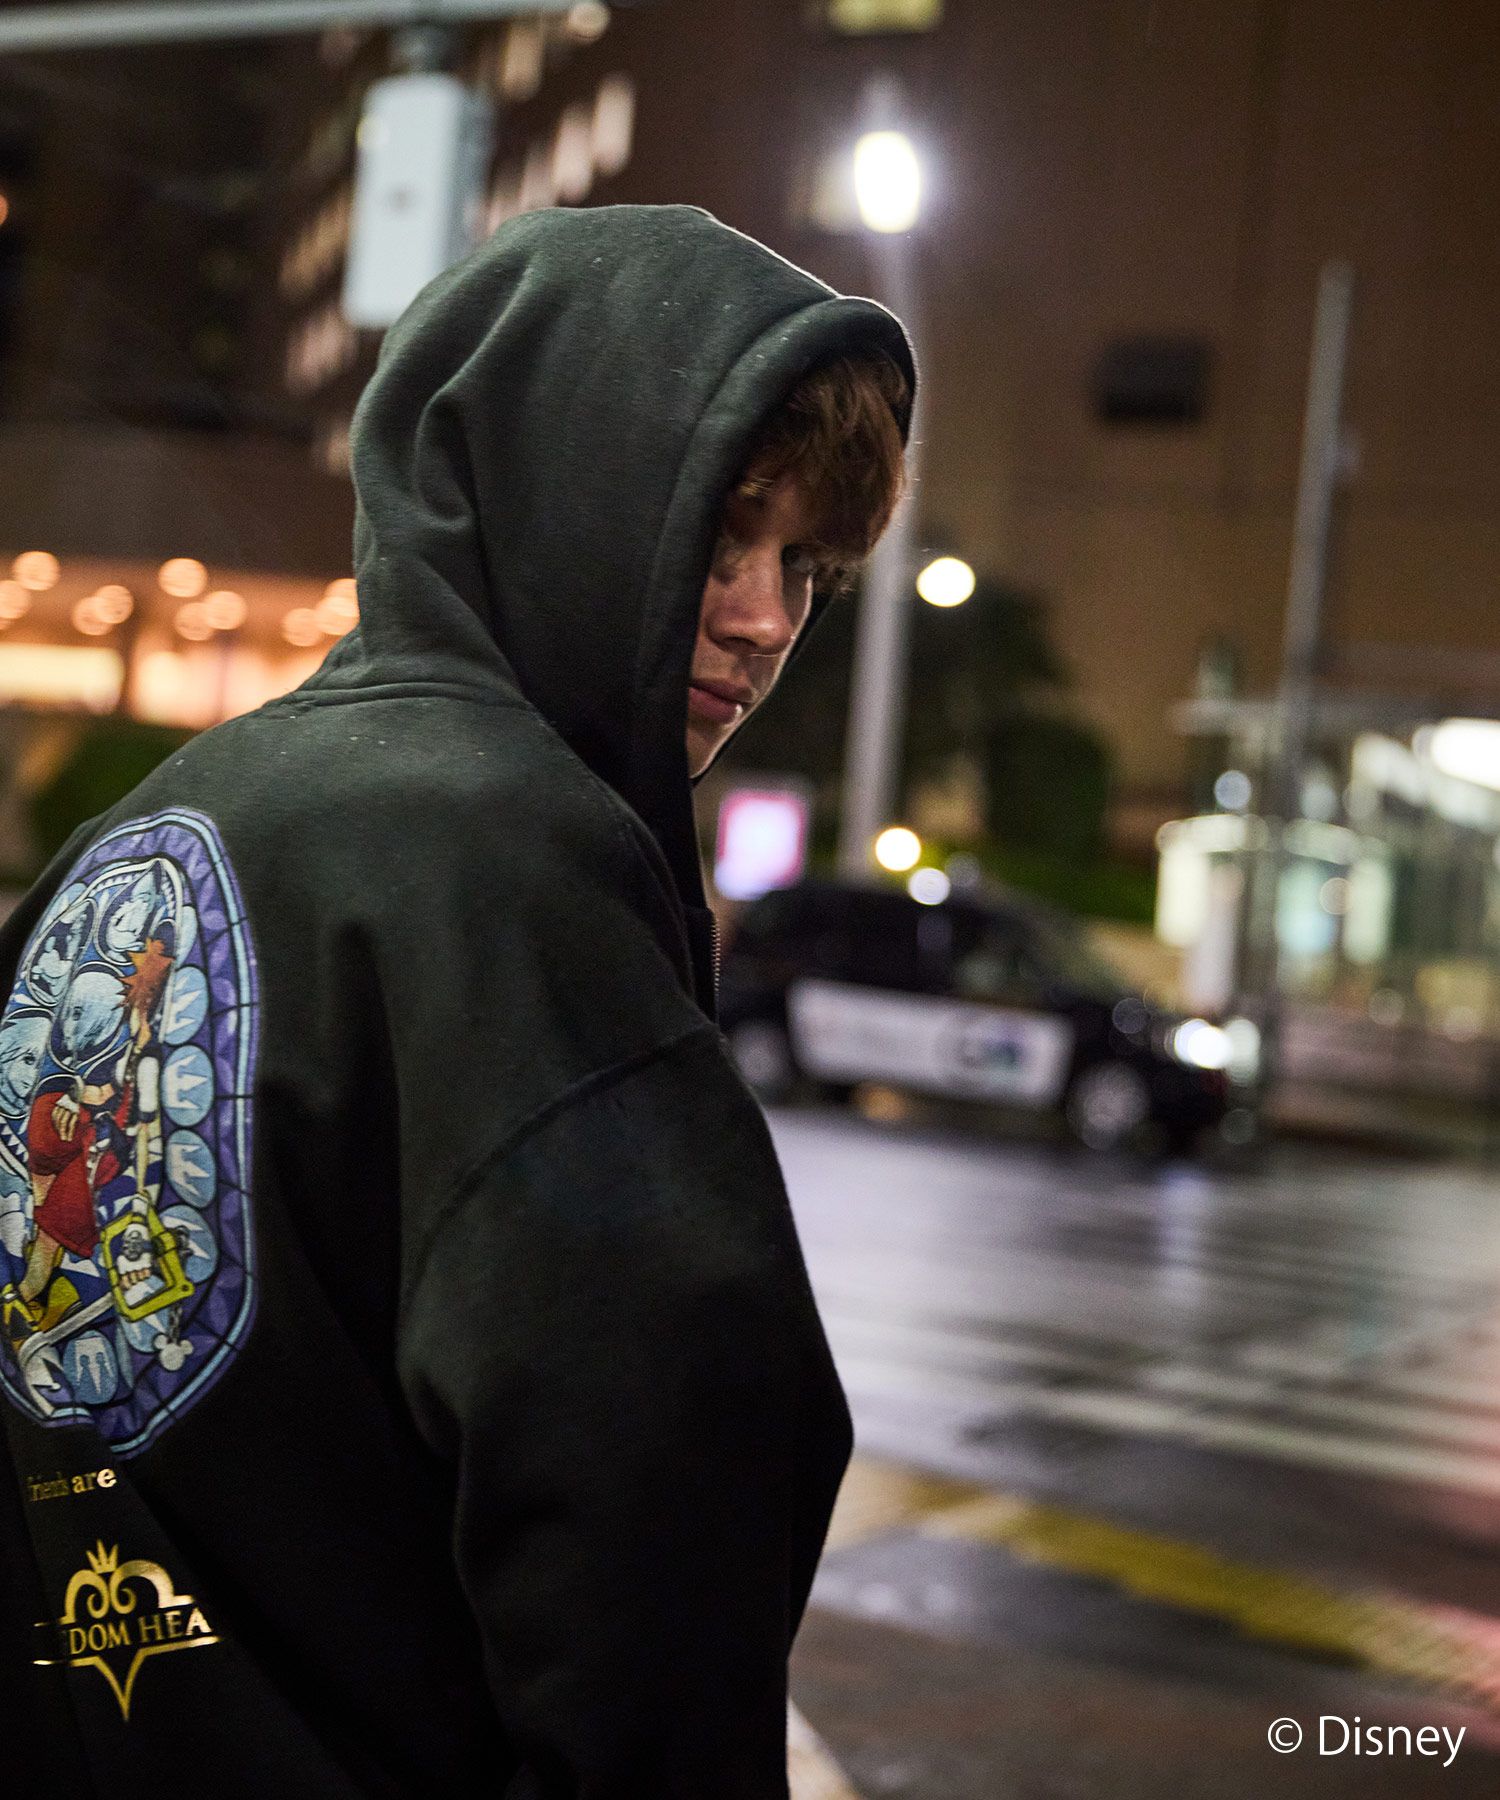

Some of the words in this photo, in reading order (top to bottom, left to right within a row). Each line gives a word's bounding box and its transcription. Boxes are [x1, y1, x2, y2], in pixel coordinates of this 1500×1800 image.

[72, 1468, 117, 1494] are
[68, 1620, 131, 1655] DOM
[139, 1608, 213, 1643] HEA
